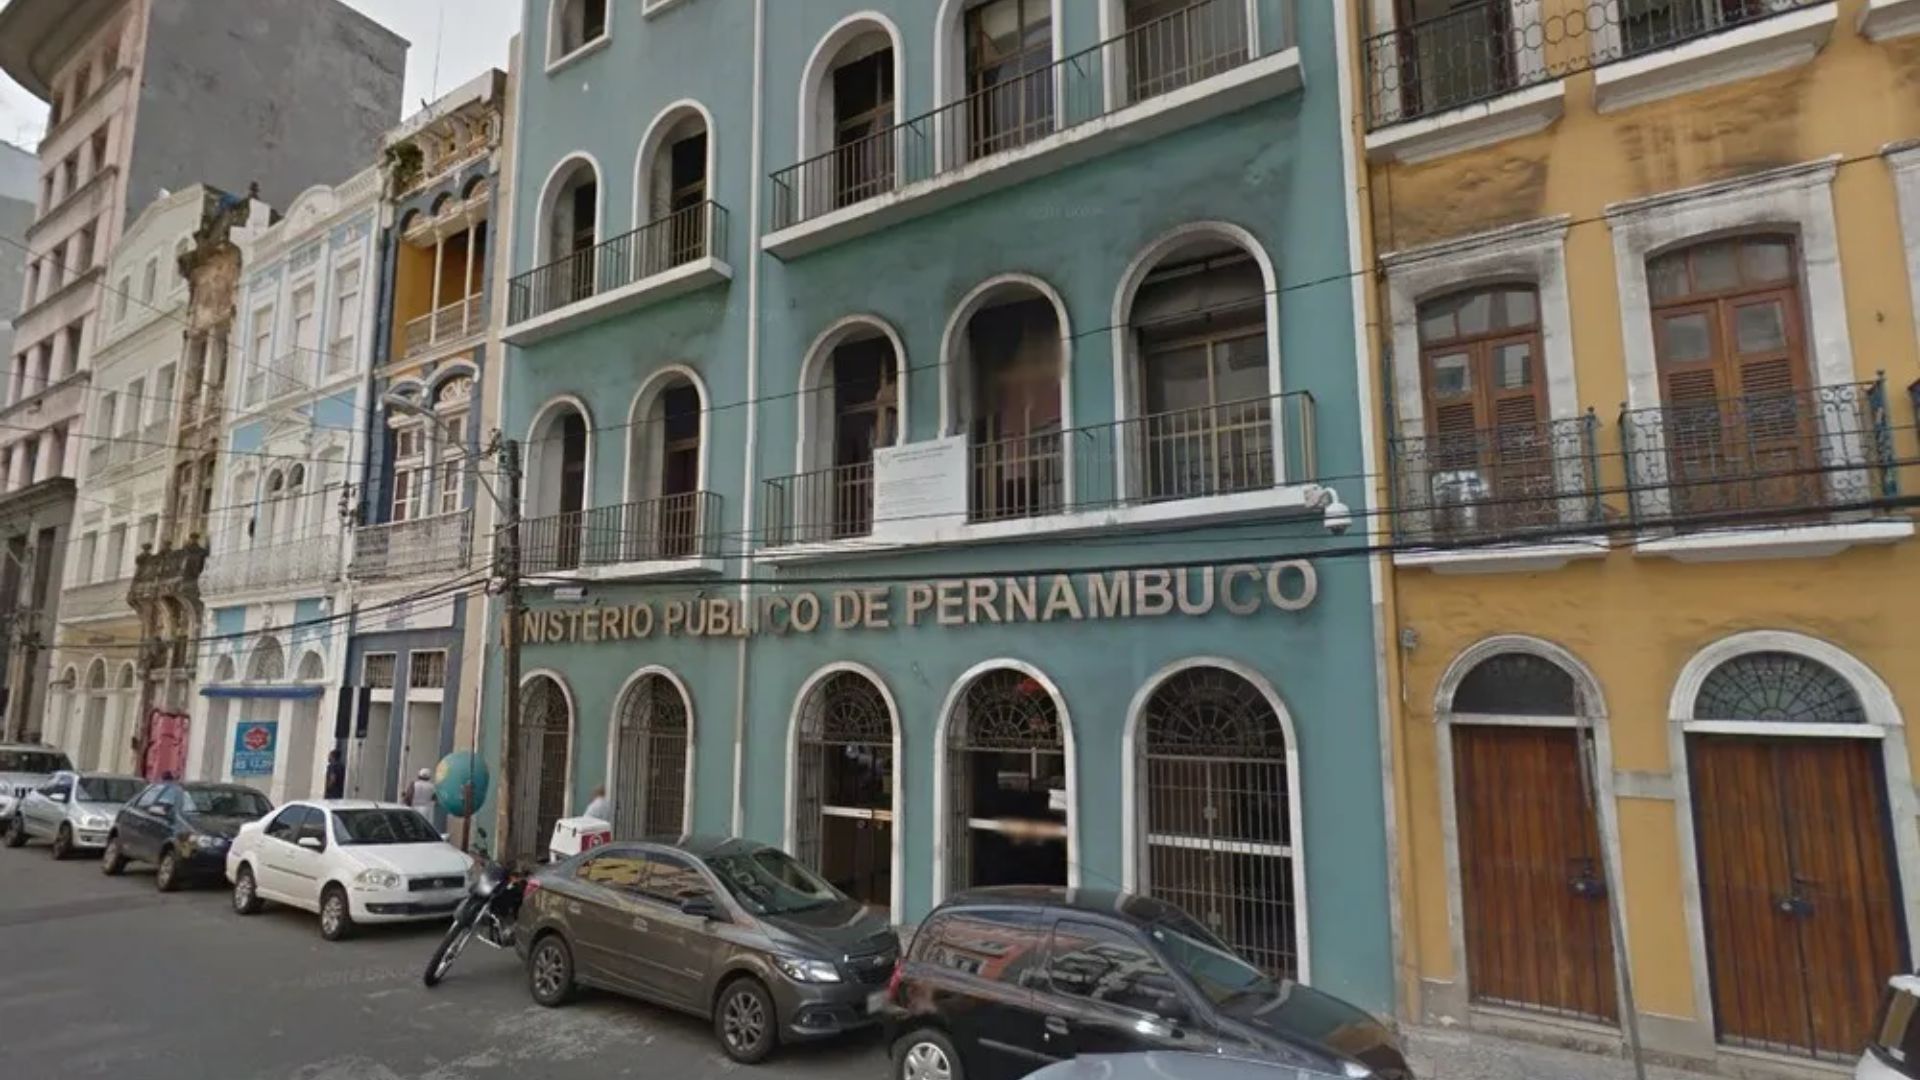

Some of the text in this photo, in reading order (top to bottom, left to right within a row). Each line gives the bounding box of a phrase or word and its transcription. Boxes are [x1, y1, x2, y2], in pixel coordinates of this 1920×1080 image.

[502, 557, 1319, 649] NISTÉRIO PÚBLICO DE PERNAMBUCO
